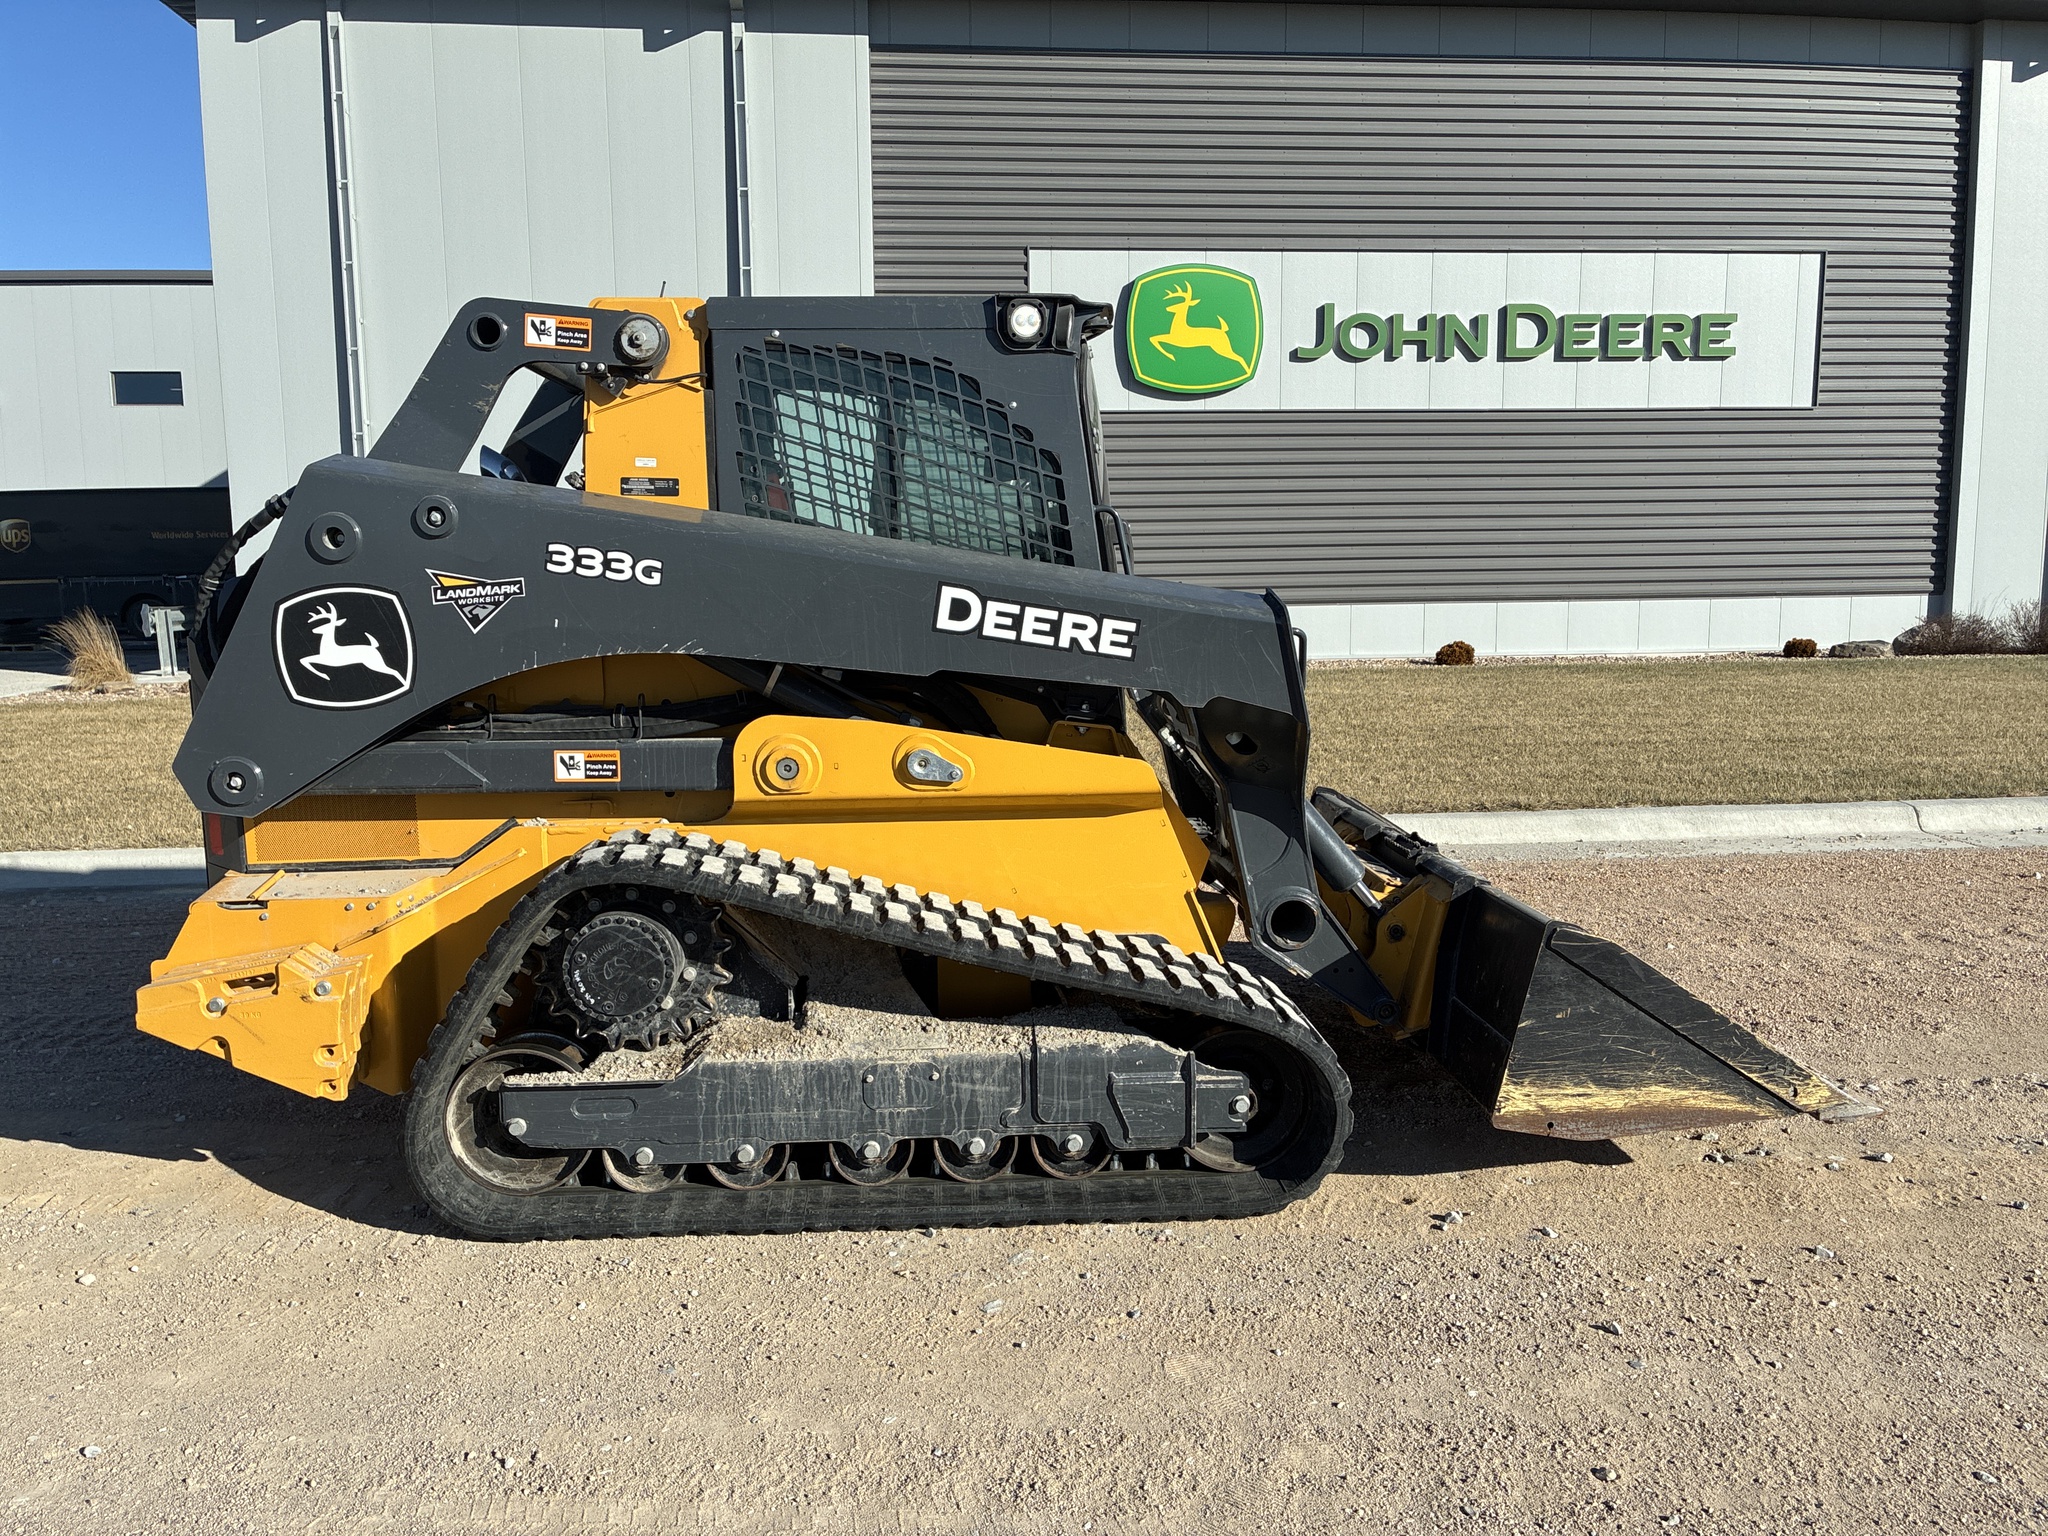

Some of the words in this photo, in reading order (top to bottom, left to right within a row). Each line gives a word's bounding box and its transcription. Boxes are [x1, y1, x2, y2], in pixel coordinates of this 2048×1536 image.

[557, 330, 573, 338] Pinch
[1294, 302, 1490, 361] JOHN
[1506, 303, 1739, 360] DEERE
[2, 529, 29, 548] ups
[150, 531, 194, 540] Worldwide
[196, 530, 230, 539] Services
[545, 543, 663, 586] 333G
[436, 583, 521, 600] LANDMARK
[457, 595, 505, 605] WORKSITE
[935, 585, 1139, 660] DEERE
